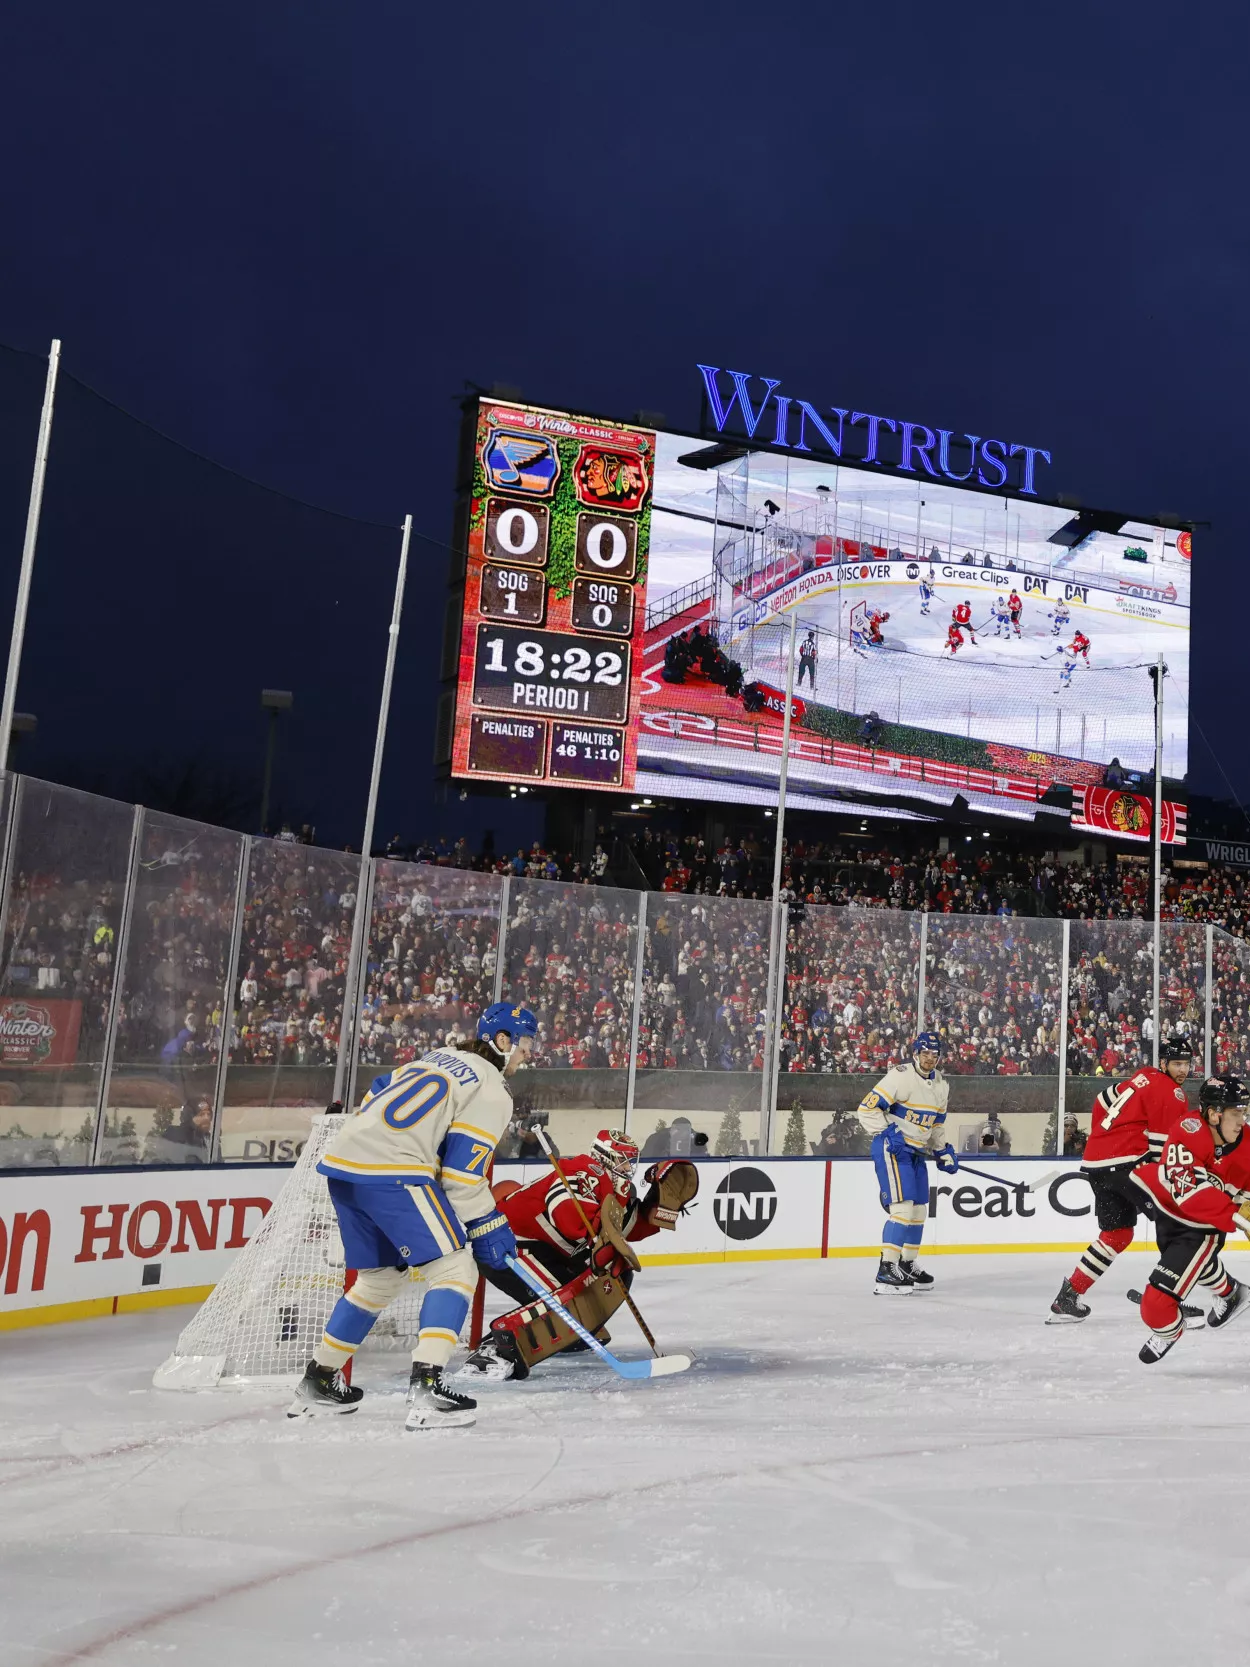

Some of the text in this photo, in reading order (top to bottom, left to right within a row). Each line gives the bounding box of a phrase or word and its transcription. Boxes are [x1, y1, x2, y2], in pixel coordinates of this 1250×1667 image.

[537, 415, 578, 435] Winter
[579, 426, 614, 439] CLASSIC
[696, 363, 1051, 495] WINTRUST
[496, 508, 539, 555] 0
[586, 522, 627, 569] 0
[498, 571, 528, 592] SOG
[799, 571, 833, 593] HONDA
[837, 565, 890, 581] DISCOVER
[942, 566, 1010, 585] Great Clips
[589, 583, 618, 604] SOG
[1023, 575, 1048, 596] CAT
[1064, 584, 1089, 604] CAT
[503, 592, 519, 615] 1
[770, 586, 797, 613] verizon
[593, 606, 612, 628] 0
[485, 638, 623, 686] 18:22
[513, 682, 579, 710] PERIOD
[763, 696, 797, 718] ASSC
[482, 721, 534, 738] PENALTIES
[564, 729, 613, 746] PENALTIES
[555, 744, 620, 762] 46 1:10
[1028, 752, 1046, 764] 2025
[358, 1065, 451, 1131] 70
[1100, 1086, 1135, 1131] 4
[1166, 1143, 1194, 1166] 86
[880, 1181, 1036, 1218] reat
[74, 1197, 274, 1263] HOND
